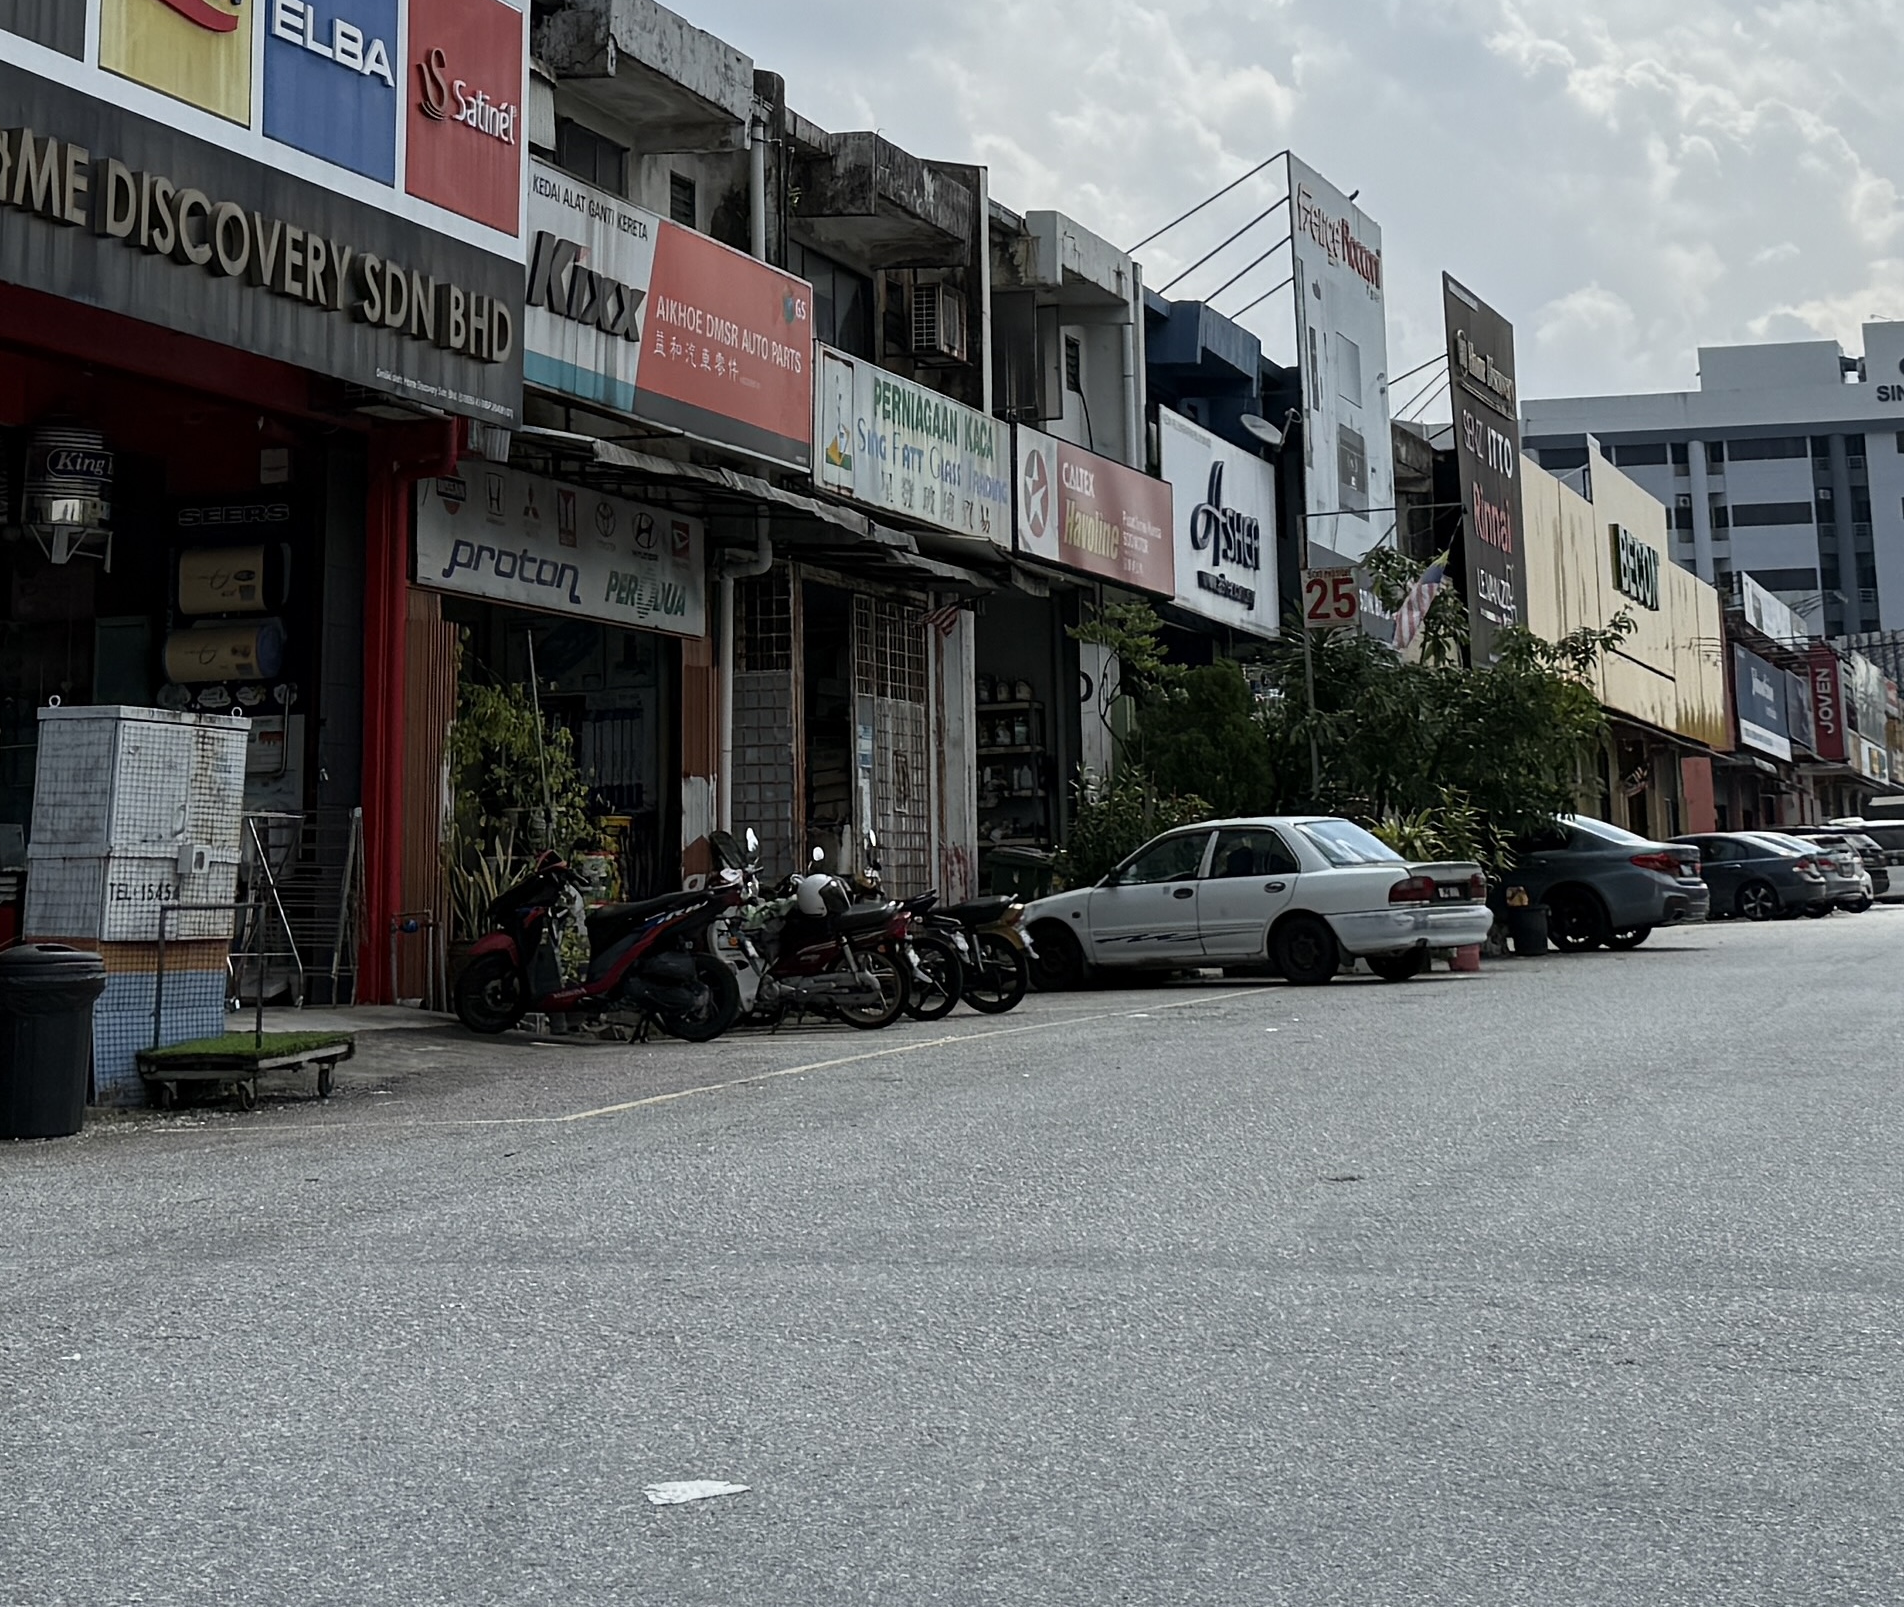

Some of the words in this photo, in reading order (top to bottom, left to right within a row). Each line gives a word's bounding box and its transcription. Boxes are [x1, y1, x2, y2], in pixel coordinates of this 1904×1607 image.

[533, 175, 561, 198] KEDAI
[563, 185, 586, 213] ALAT
[588, 200, 615, 227] GANTI
[617, 212, 648, 242] KERETA
[99, 157, 352, 311] DISCOVERY
[353, 252, 435, 341] SDN
[435, 281, 513, 363] BHD
[655, 295, 703, 335] AIKHOE
[706, 313, 739, 345] DMSR
[742, 328, 769, 361] AUTO
[772, 341, 802, 374] PARTS
[795, 299, 807, 321] GS
[874, 375, 958, 446] PERNIAGAAN
[964, 415, 994, 462] KACA
[1063, 462, 1095, 498] CALTEX
[178, 503, 290, 527] SEERS
[1064, 498, 1120, 560] Havoline
[1472, 481, 1512, 554] Rinnai
[442, 538, 581, 605] proton
[1306, 577, 1356, 620] 25
[1817, 668, 1834, 734] JOVEN
